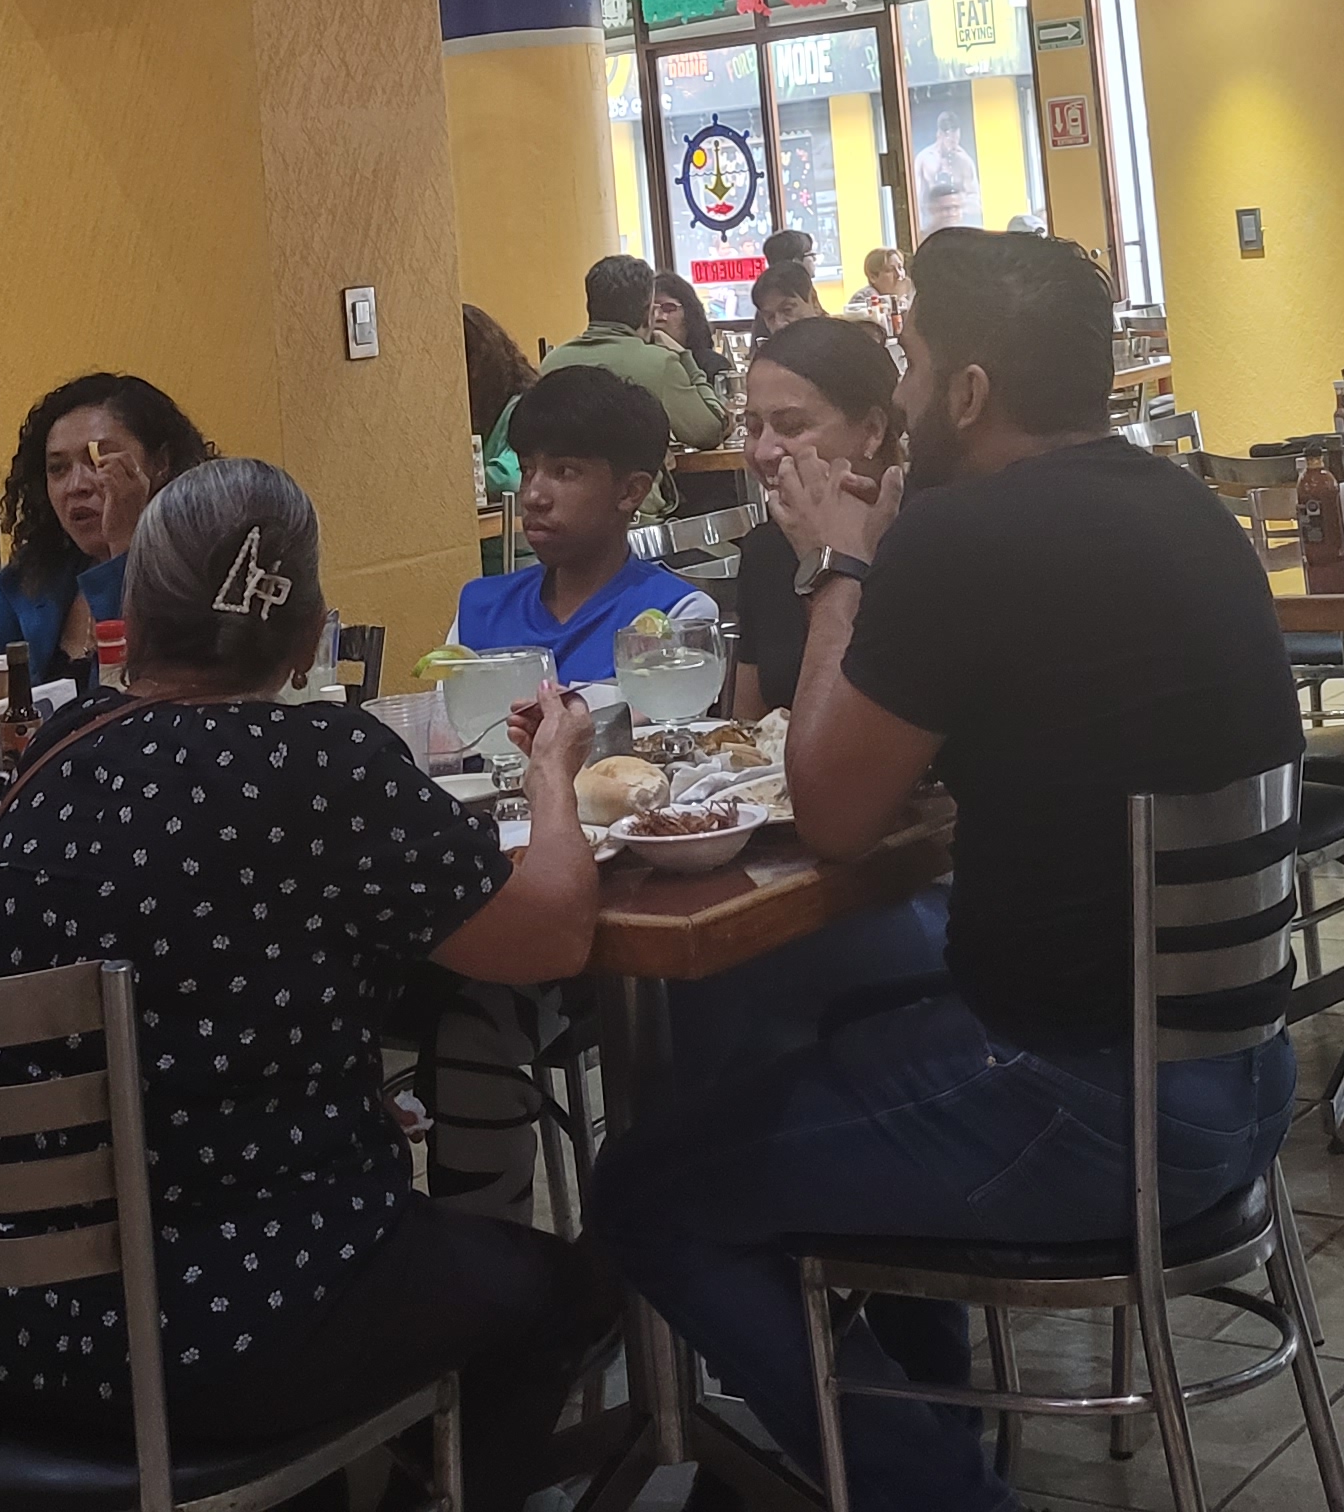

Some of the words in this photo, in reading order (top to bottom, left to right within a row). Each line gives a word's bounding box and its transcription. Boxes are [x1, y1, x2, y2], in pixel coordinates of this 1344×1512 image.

[959, 26, 994, 42] CRYING
[668, 61, 709, 79] DOING
[725, 49, 757, 83] FORE
[776, 40, 834, 89] MODE
